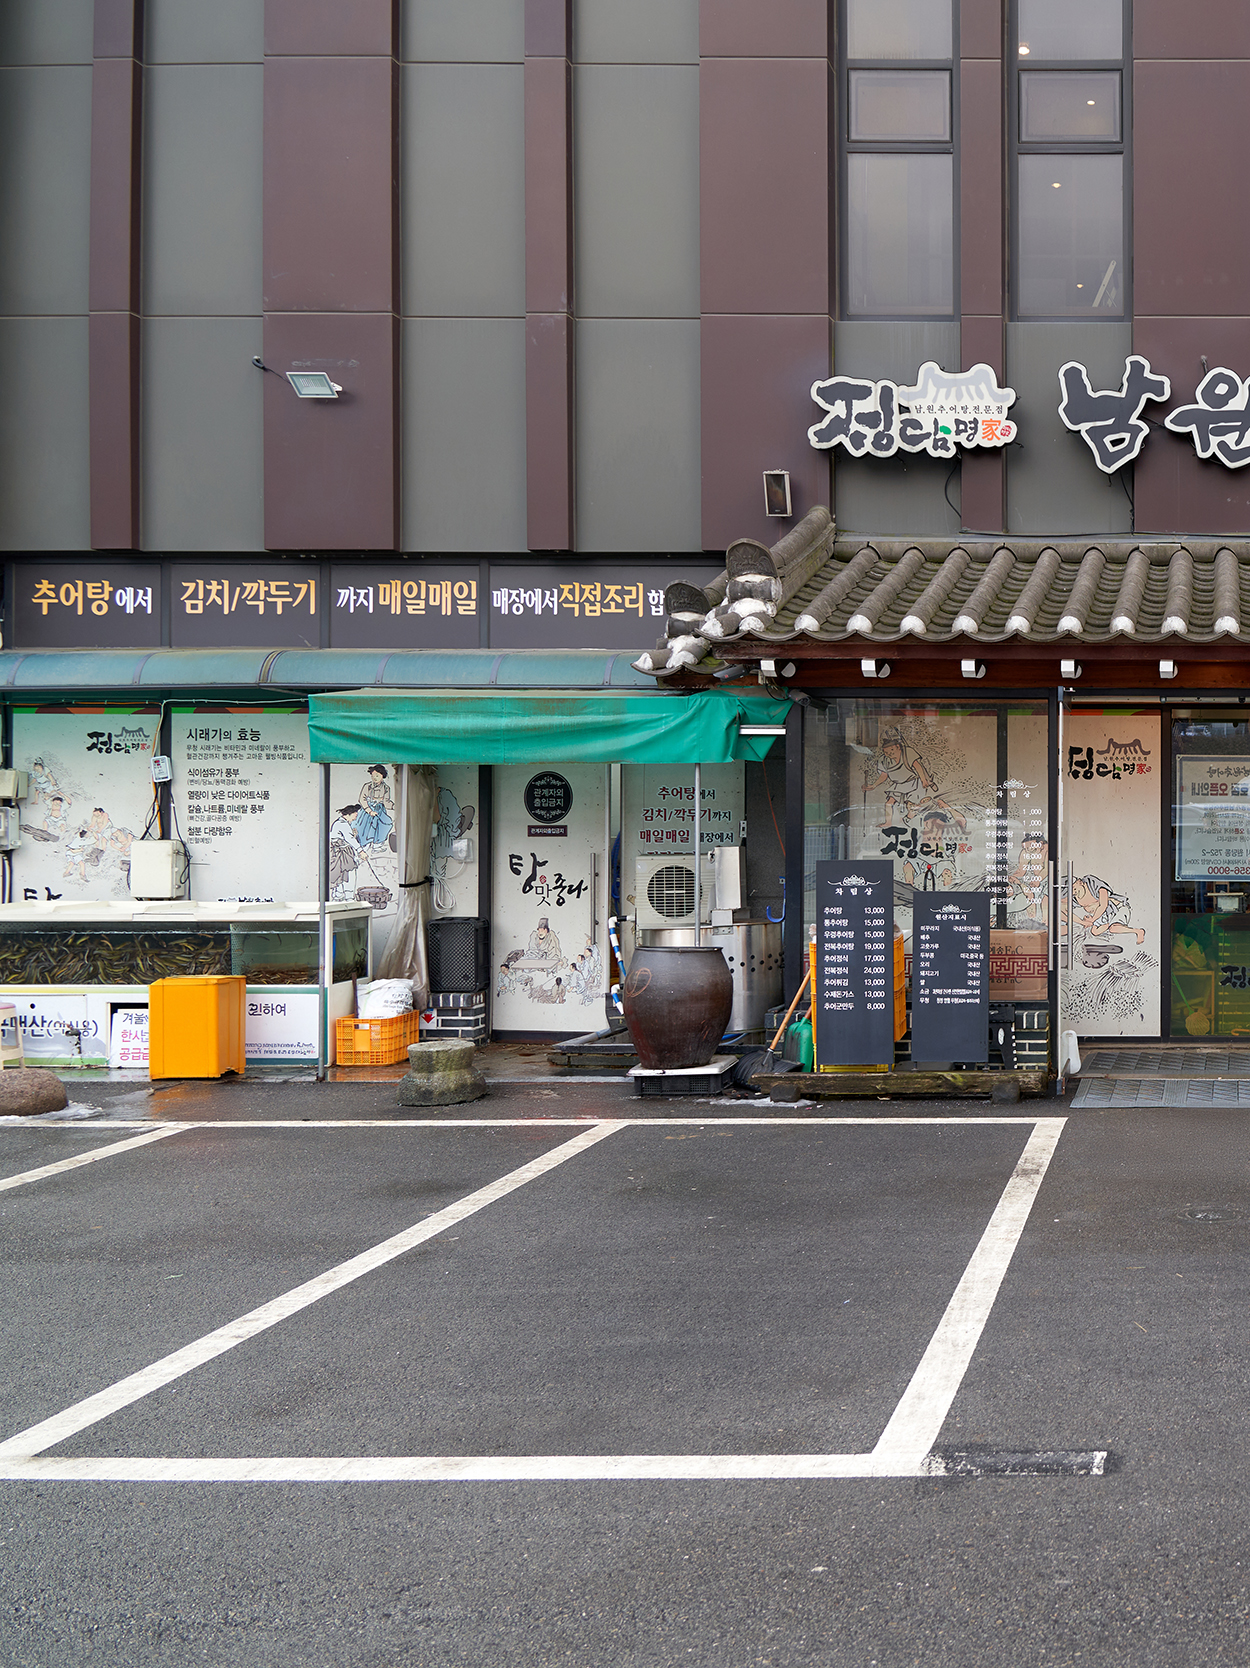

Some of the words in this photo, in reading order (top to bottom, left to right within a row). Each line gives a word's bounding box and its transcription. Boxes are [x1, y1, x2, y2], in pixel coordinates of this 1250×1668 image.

[32, 579, 153, 615] 추어탕에서
[180, 579, 316, 615] 김치/깍두기
[337, 586, 373, 613] 까지
[378, 579, 476, 615] 매일매일
[187, 728, 232, 741] 시래기의
[237, 728, 261, 742] 효능
[200, 744, 222, 752] 시래기는
[224, 744, 246, 752] 비타민과
[249, 744, 271, 752] 미네랄이
[273, 744, 295, 752] 풍부하고
[187, 768, 223, 777] 식이섬유가
[225, 768, 240, 777] 풍부
[187, 790, 209, 800] 열량이
[211, 790, 225, 800] 낮은
[227, 790, 270, 800] 다이어트식품
[534, 788, 564, 797] 관계자외
[534, 798, 564, 807] 출입금지
[249, 804, 265, 814] 풍부
[640, 829, 690, 843] 매일매일
[509, 853, 548, 894] 탕
[552, 873, 588, 906] 좋다
[864, 907, 885, 915] 13,000
[864, 919, 885, 927] 15,000
[864, 931, 885, 939] 15,000
[864, 943, 885, 951] 19,000
[864, 955, 885, 963] 17,000
[864, 967, 885, 975] 24,000
[864, 979, 885, 987] 13,000
[864, 991, 885, 999] 13,000
[867, 1003, 885, 1011] 8,000
